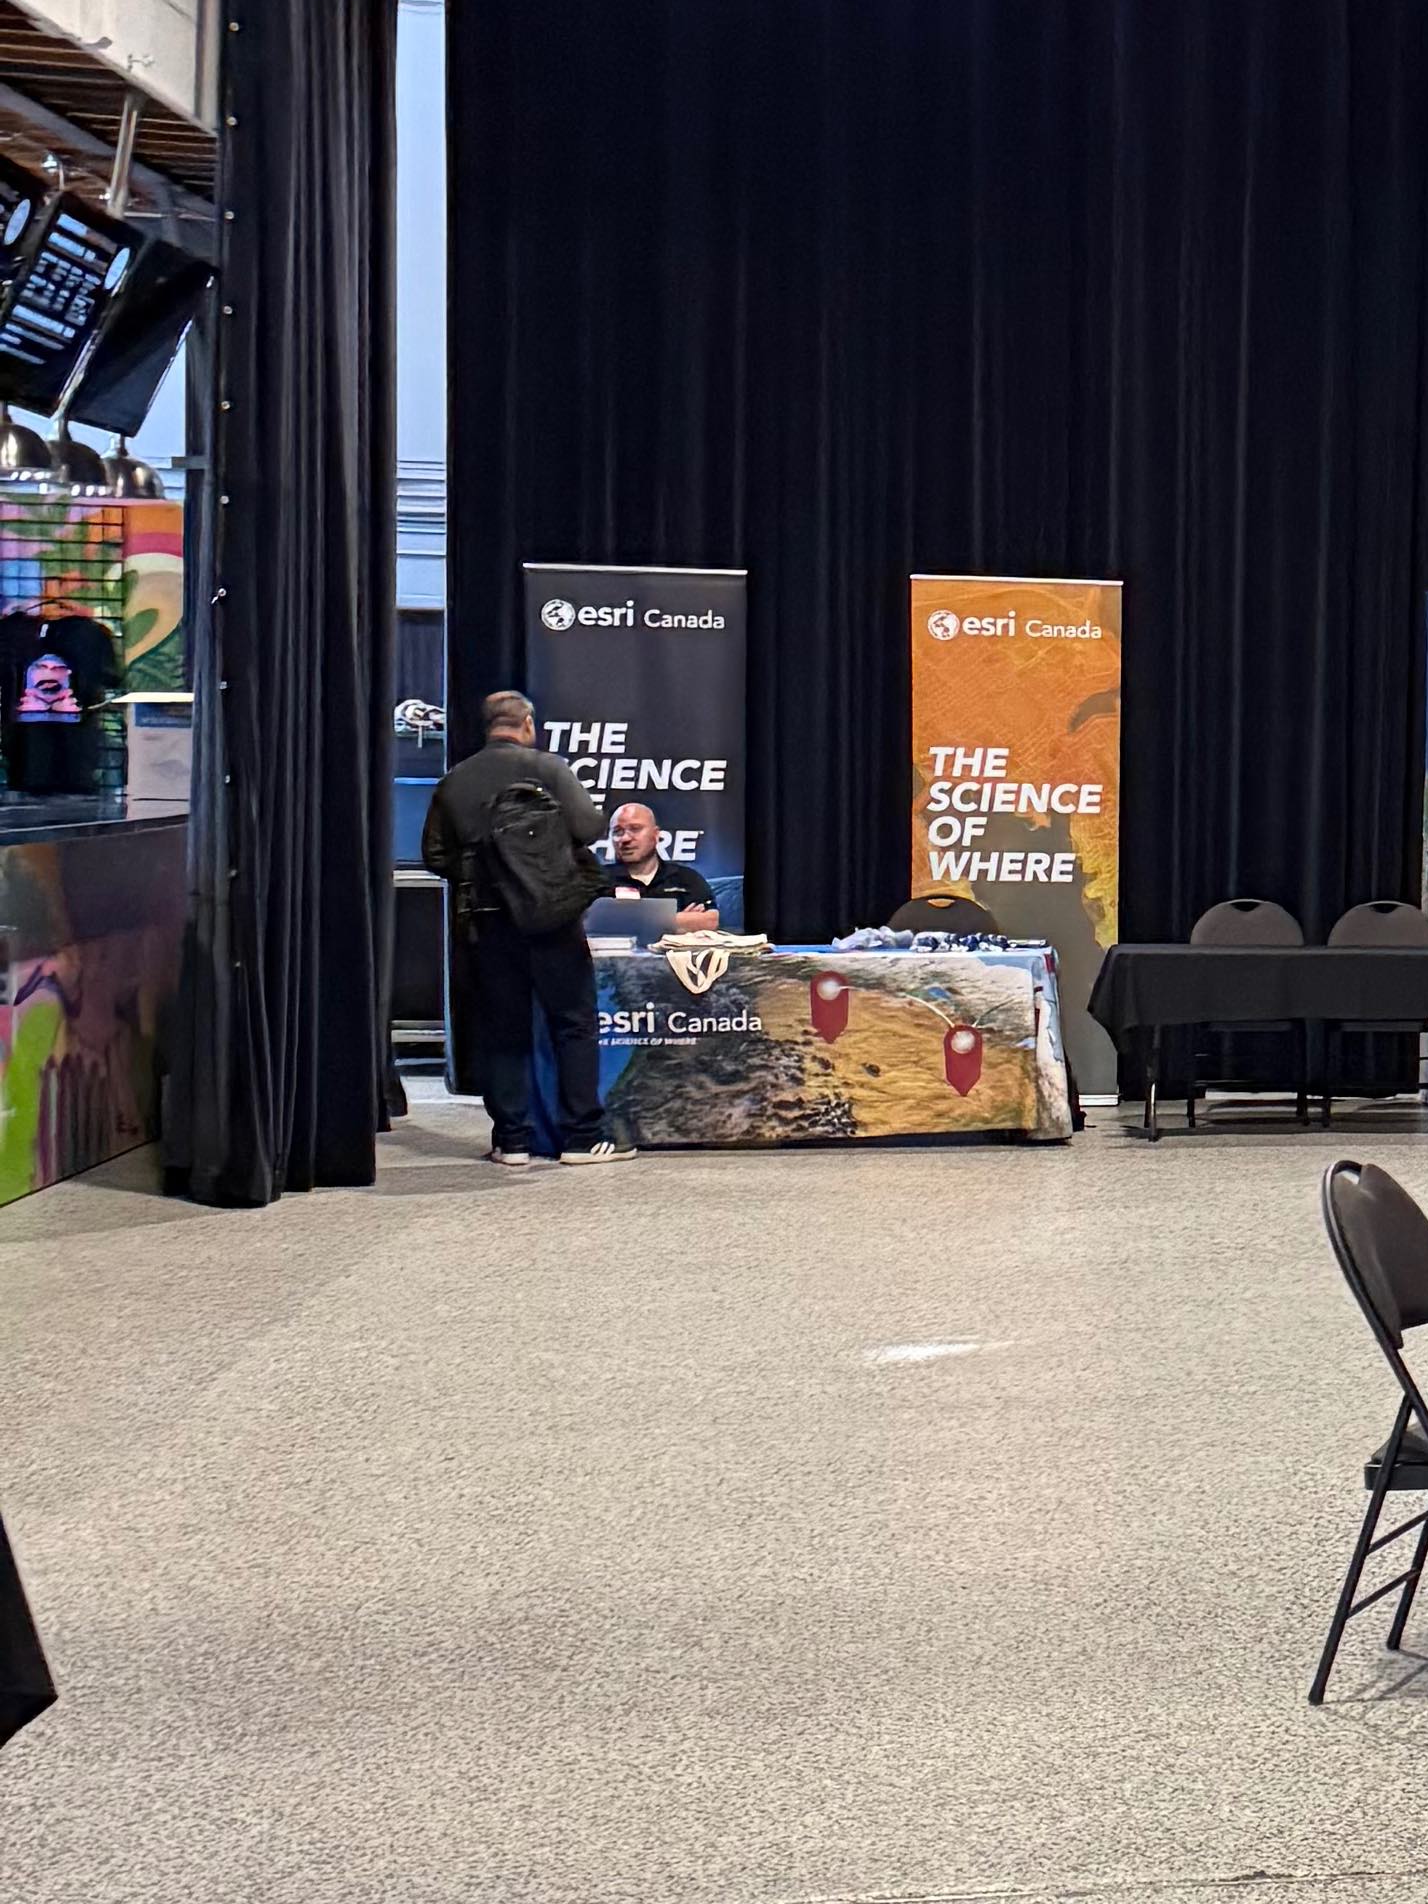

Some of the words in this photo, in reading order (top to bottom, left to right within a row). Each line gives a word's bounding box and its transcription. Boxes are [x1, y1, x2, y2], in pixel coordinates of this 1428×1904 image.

[577, 600, 635, 627] esri
[643, 609, 725, 629] Canada
[962, 610, 1016, 637] esri
[1024, 619, 1102, 639] Canada
[543, 721, 628, 753] THE
[565, 757, 727, 791] CIENCE
[928, 746, 1010, 778] THE
[926, 781, 1104, 814] SCIENCE
[927, 815, 988, 847] OF
[928, 851, 1077, 883] WHERE
[667, 1009, 762, 1034] Canada
